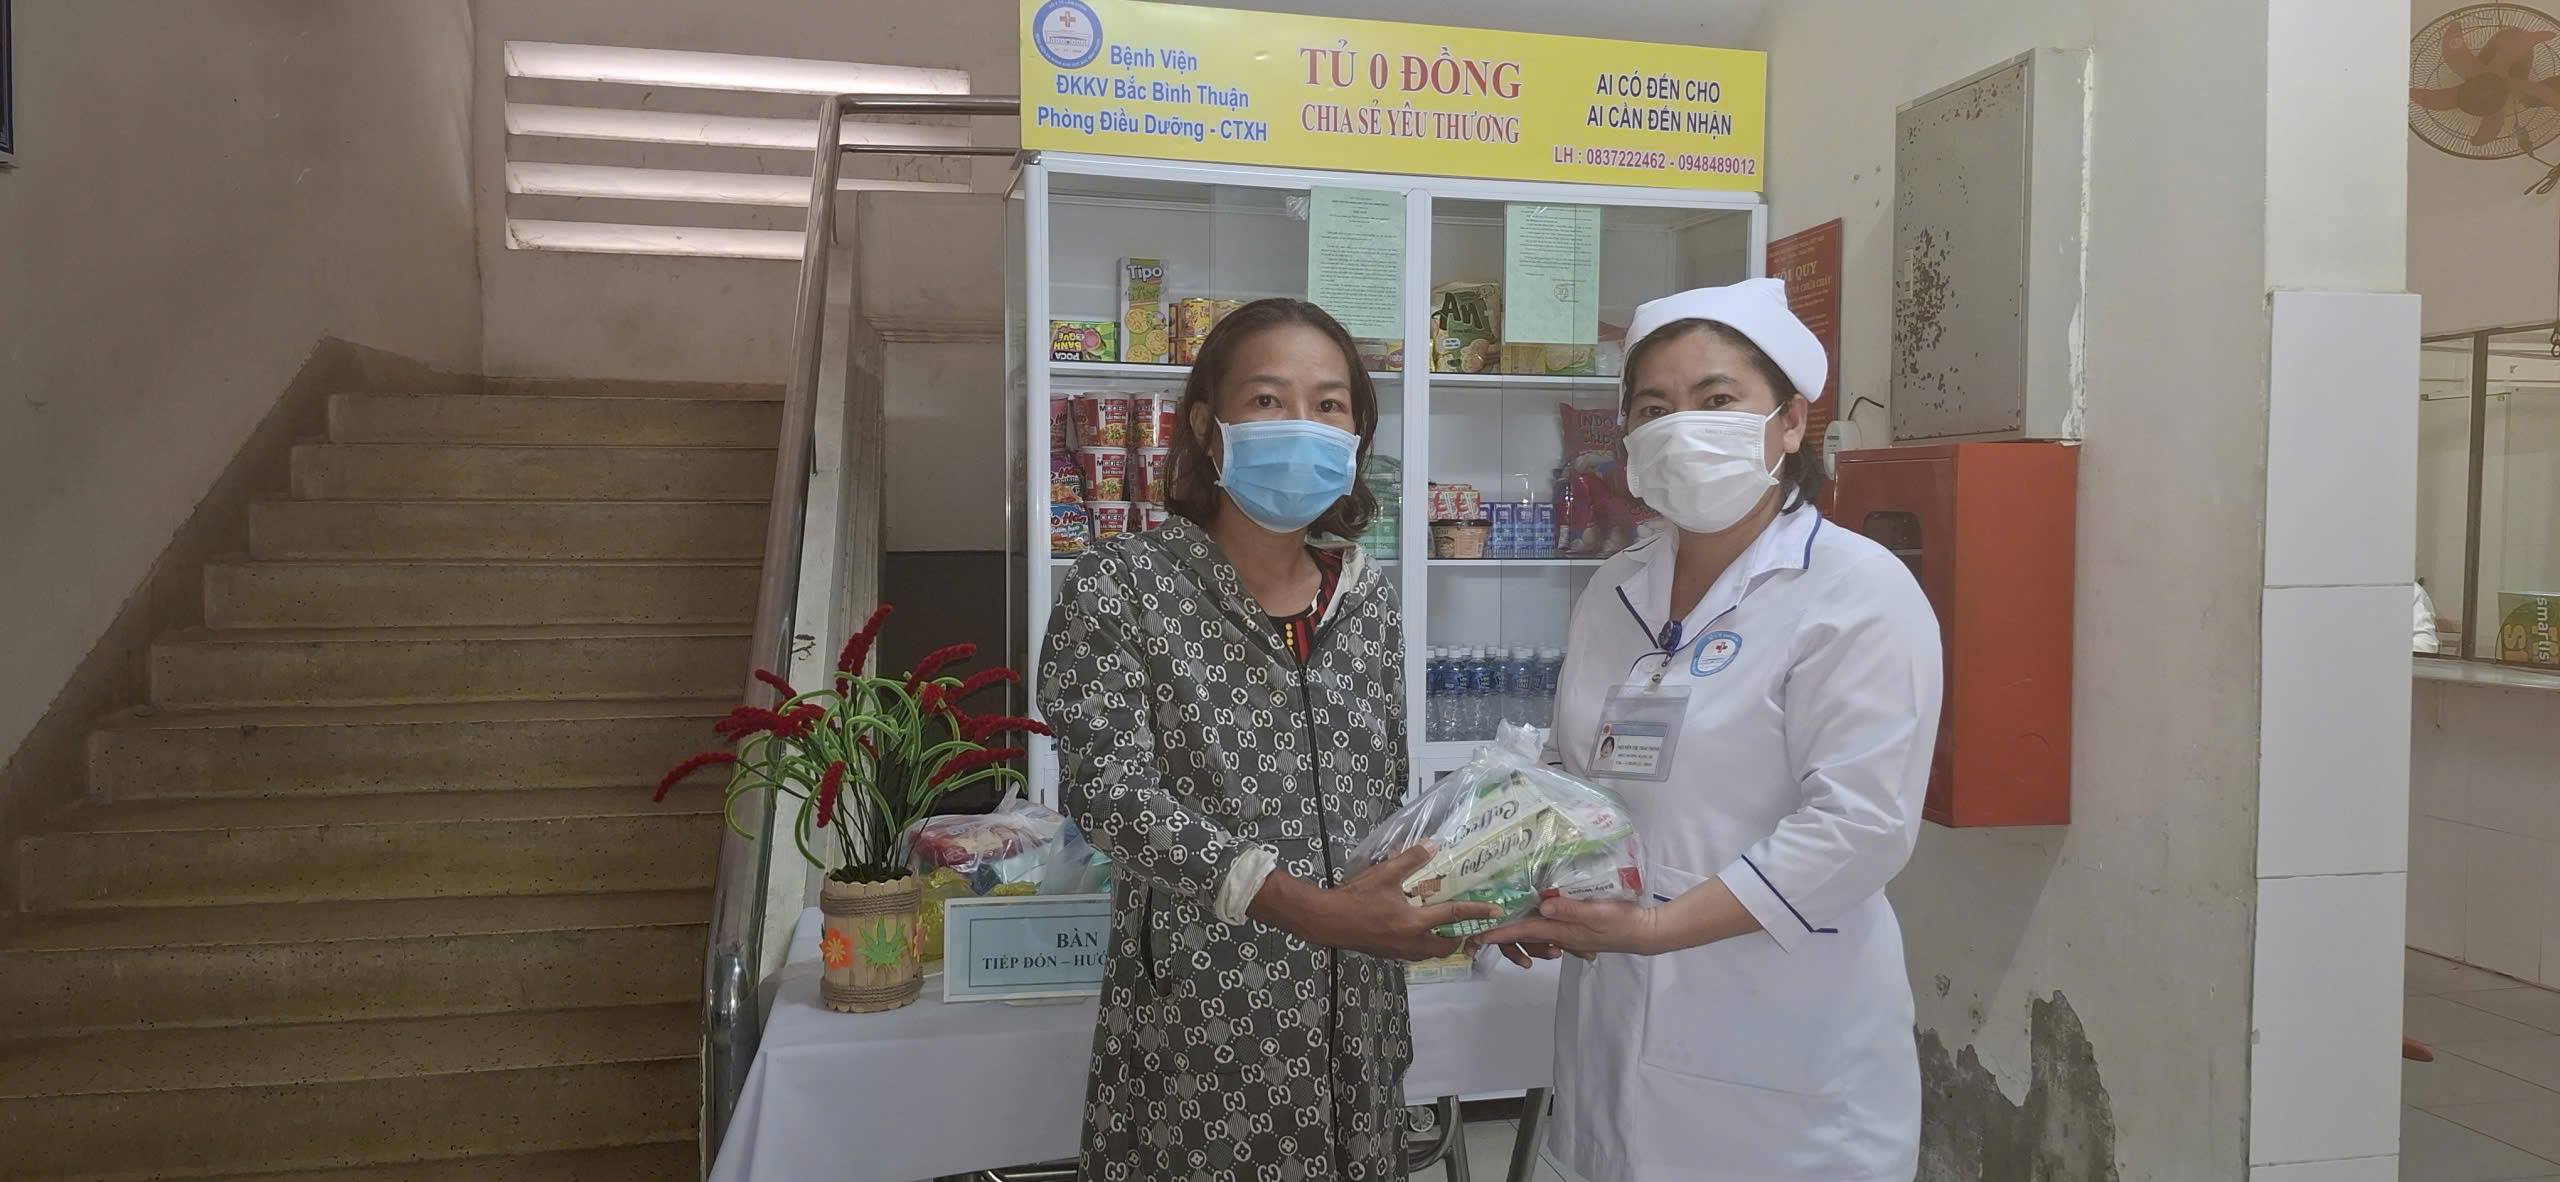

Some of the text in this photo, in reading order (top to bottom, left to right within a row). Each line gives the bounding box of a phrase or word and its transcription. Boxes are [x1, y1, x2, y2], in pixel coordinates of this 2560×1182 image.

[1110, 45, 1197, 75] Bệnh Viện
[1300, 39, 1522, 98] TỦ 0 ĐỒNG
[1056, 74, 1249, 111] ĐKKV Bắc Bình Thuận
[1597, 70, 1720, 103] AI CÓ ĐẾN CHO
[1038, 105, 1094, 135] Phòng
[1100, 108, 1139, 133] Điều
[1144, 115, 1204, 142] Dưỡng
[1220, 120, 1267, 142] CTXH
[1302, 98, 1520, 144] CHIA SẺ YÊU THƯƠNG
[1587, 102, 1732, 140] AI CẦN ĐẾN NHẬN
[1555, 146, 1573, 163] LH
[1586, 148, 1665, 170] 0837222462
[1678, 154, 1755, 175] 0948489012
[1128, 265, 1163, 282] Tipo
[1054, 351, 1080, 361] POCA
[1057, 928, 1099, 949] BÀN
[1023, 952, 1057, 969] ĐÓN
